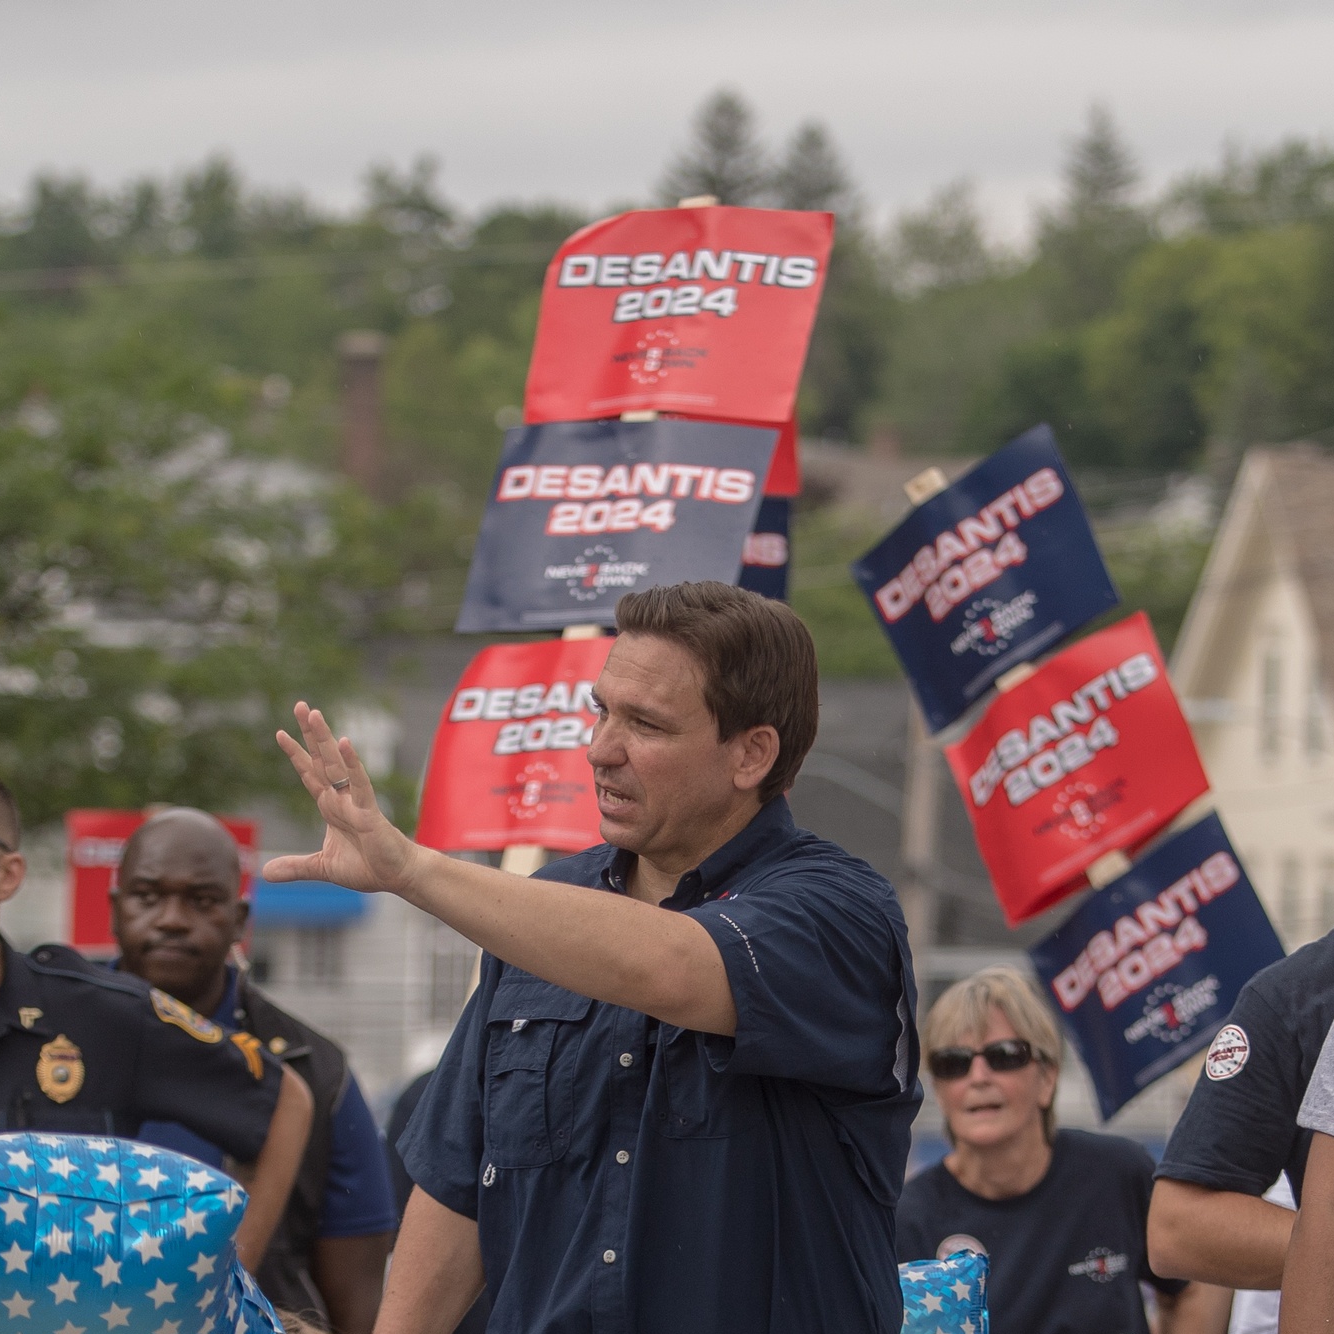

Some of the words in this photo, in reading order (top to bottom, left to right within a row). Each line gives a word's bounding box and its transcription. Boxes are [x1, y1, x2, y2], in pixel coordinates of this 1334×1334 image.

[558, 249, 818, 288] DESANTIS
[612, 285, 738, 323] 2024
[496, 463, 756, 502] DESANTIS
[545, 499, 676, 536] 2024
[875, 466, 1065, 625] DESANTIS
[544, 564, 599, 580] NEVE
[924, 530, 1028, 624] 2024
[450, 681, 599, 722] DESAN
[493, 717, 593, 755] 202
[968, 652, 1158, 807] DESANTIS
[1003, 715, 1119, 807] 2024
[1051, 851, 1241, 1012] DESANTIS
[1096, 915, 1209, 1012] 2024
